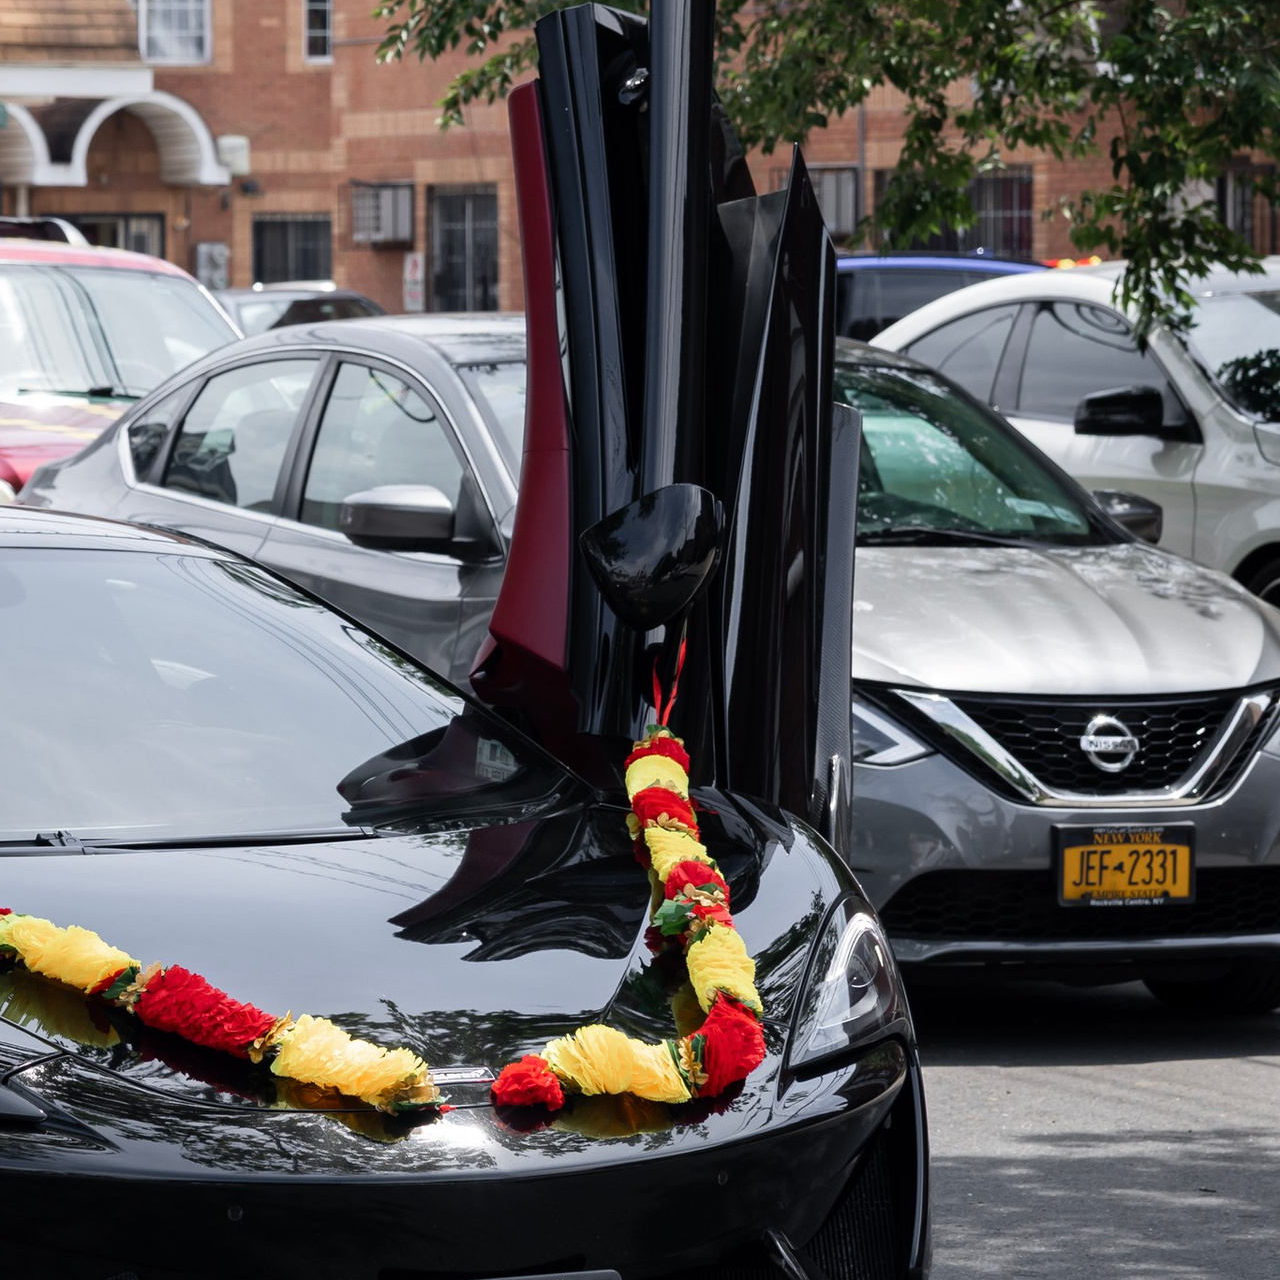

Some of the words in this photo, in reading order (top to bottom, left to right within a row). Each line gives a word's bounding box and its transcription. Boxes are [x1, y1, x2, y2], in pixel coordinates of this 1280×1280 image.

[1088, 738, 1136, 751] NISSAN
[1093, 833, 1126, 845] NEW
[1128, 832, 1162, 844] YORK
[1072, 849, 1112, 887] JEF
[1128, 848, 1178, 886] 2331
[1129, 888, 1159, 898] STATE
[1090, 898, 1123, 907] Rockville
[1152, 897, 1164, 905] NY
